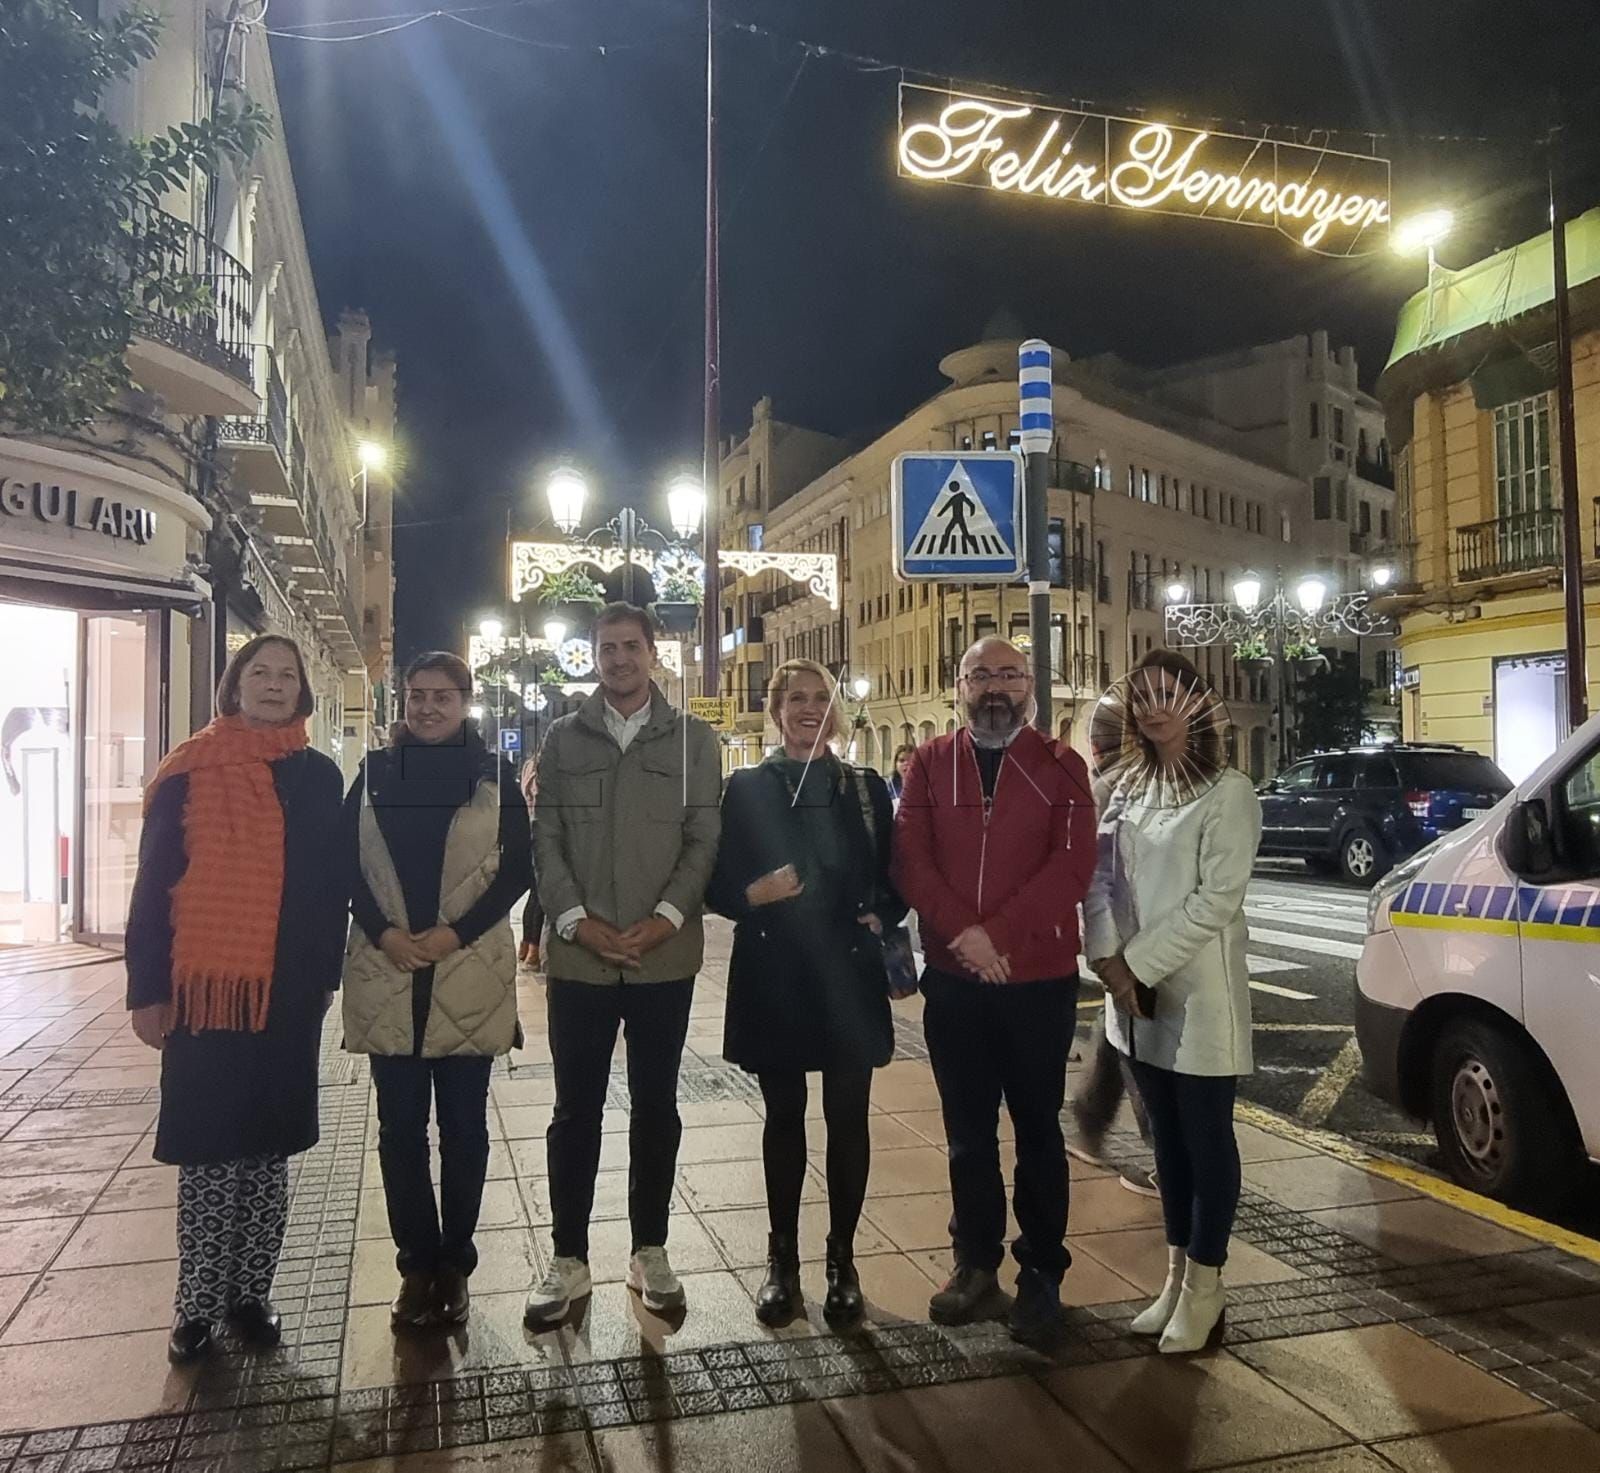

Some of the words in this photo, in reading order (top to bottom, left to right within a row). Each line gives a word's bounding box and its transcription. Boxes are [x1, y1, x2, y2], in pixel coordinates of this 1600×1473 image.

[898, 101, 1106, 200] Feliz
[1110, 123, 1391, 248] Yennayer
[504, 731, 518, 749] P
